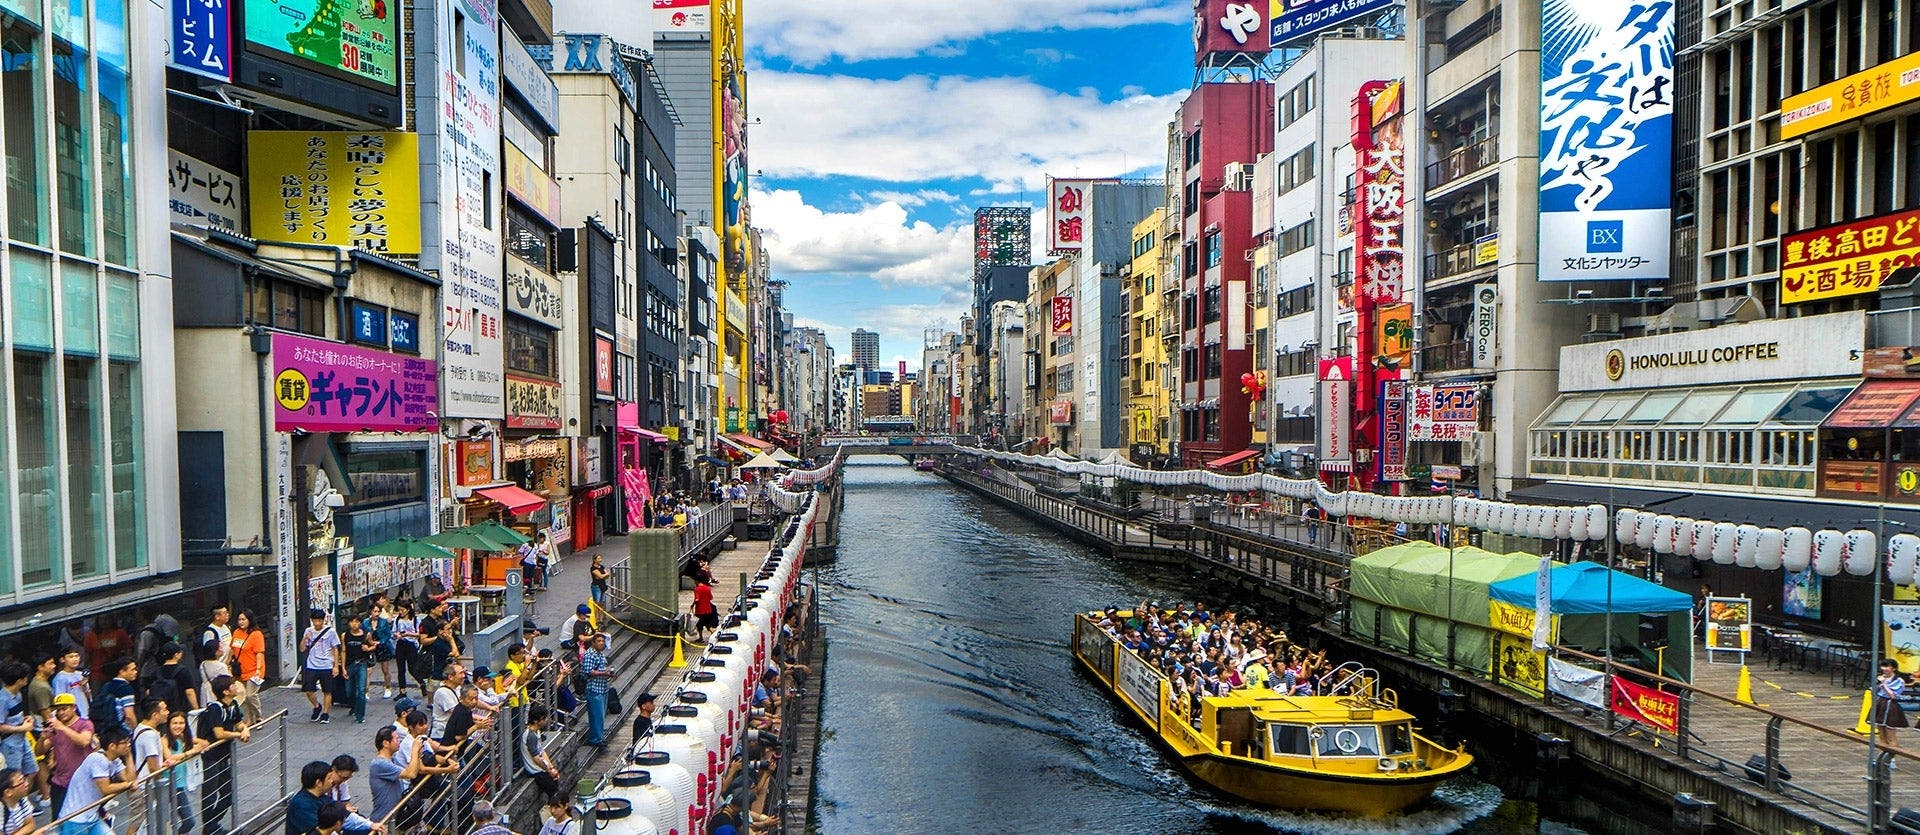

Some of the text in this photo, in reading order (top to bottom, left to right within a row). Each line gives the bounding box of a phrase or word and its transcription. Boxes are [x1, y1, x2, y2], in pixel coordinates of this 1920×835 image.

[1220, 3, 1261, 43] や
[342, 43, 358, 70] 30
[280, 175, 304, 233] 応援します
[307, 136, 330, 242] あなたのお店づくり
[1363, 141, 1404, 301] 大阪王将
[1592, 229, 1618, 244] BX
[1784, 216, 1920, 266] 豊後高田ど
[1807, 260, 1875, 294] 酒場
[446, 305, 471, 332] コスパ
[1062, 299, 1070, 321] ツルハ
[1480, 306, 1490, 337] ZERO
[1630, 342, 1778, 371] HONOLULU COFFEE
[280, 378, 305, 401] 賃貸
[311, 370, 403, 418] ギャラント
[1415, 388, 1431, 419] 薬
[1435, 390, 1475, 409] ダイコク
[1387, 401, 1401, 442] ダイコク
[1431, 423, 1457, 438] 免税
